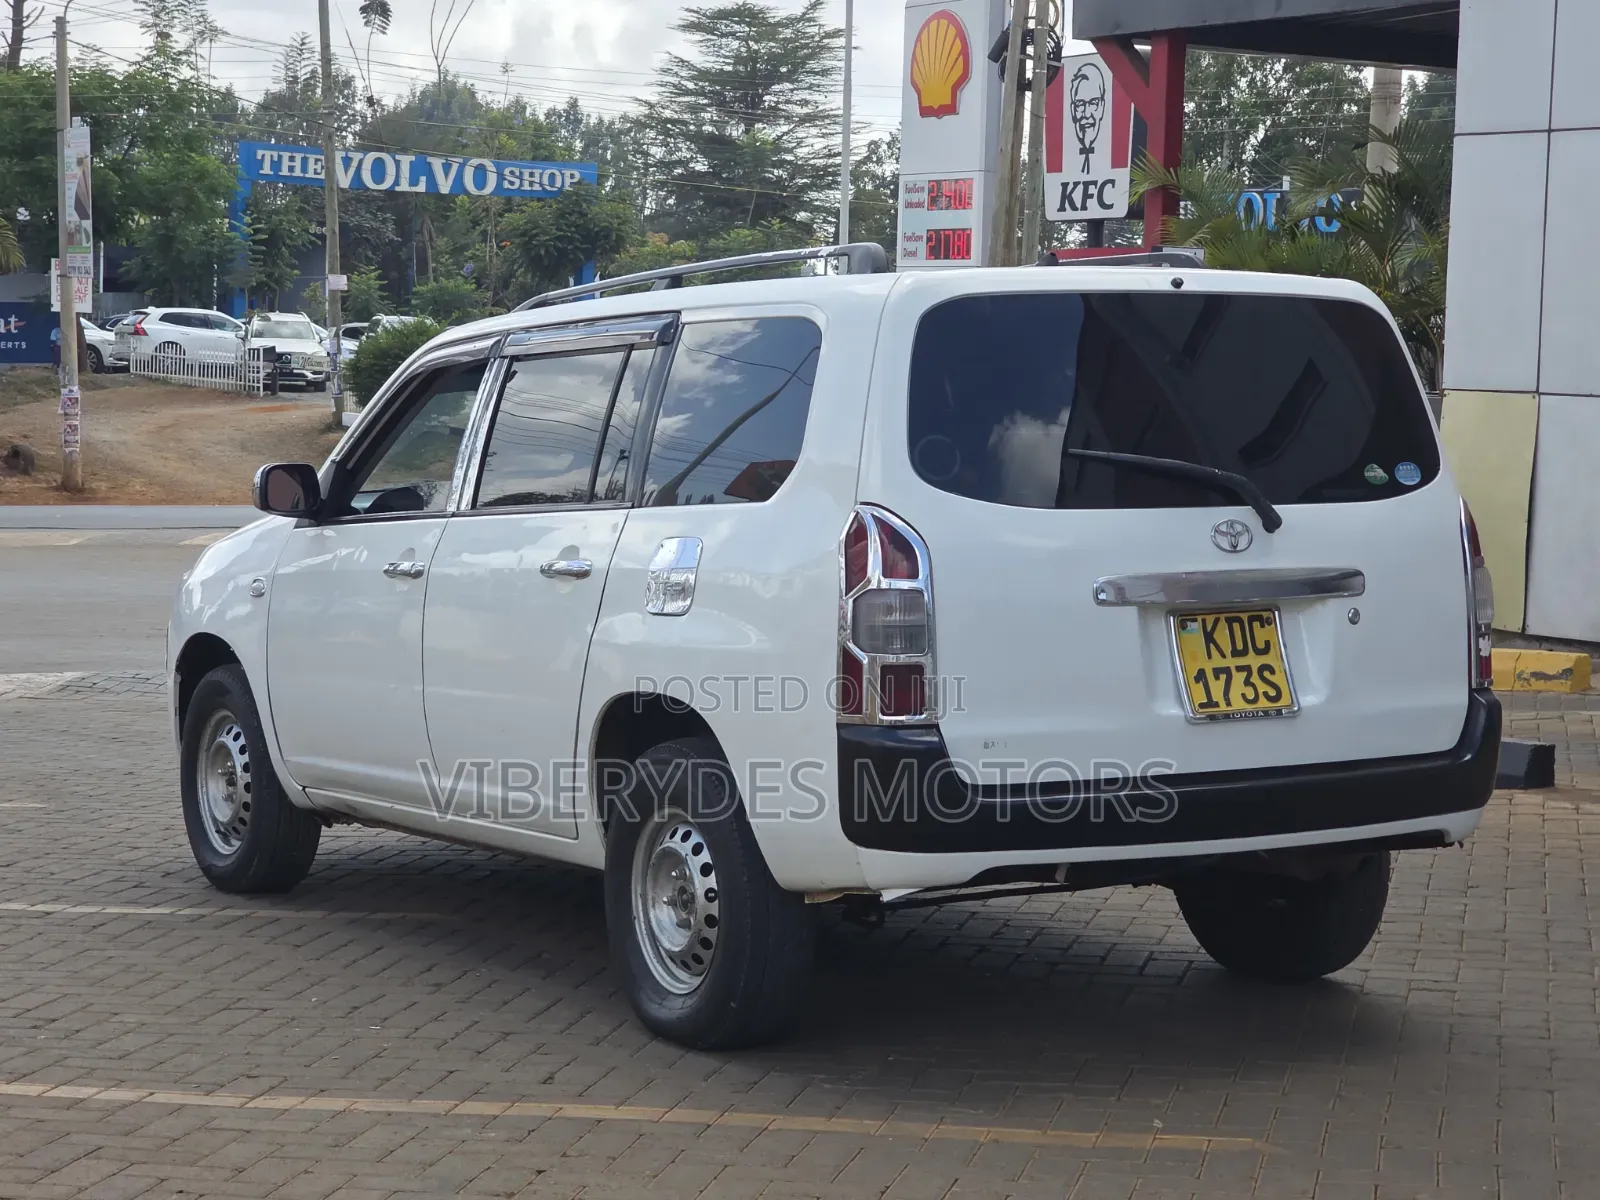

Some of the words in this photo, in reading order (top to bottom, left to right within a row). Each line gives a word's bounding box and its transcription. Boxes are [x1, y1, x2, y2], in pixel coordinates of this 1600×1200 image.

[256, 149, 325, 180] THE
[334, 150, 498, 196] VOLVO
[503, 167, 581, 191] SHOP
[904, 183, 925, 194] FuelSave
[1057, 178, 1116, 213] KFC
[904, 199, 925, 209] Unleaded
[903, 232, 924, 243] FuelSave
[903, 247, 918, 258] Diesel
[1201, 614, 1271, 660] KDC
[1193, 663, 1283, 710] 173S
[1229, 710, 1265, 719] TOYOTA
